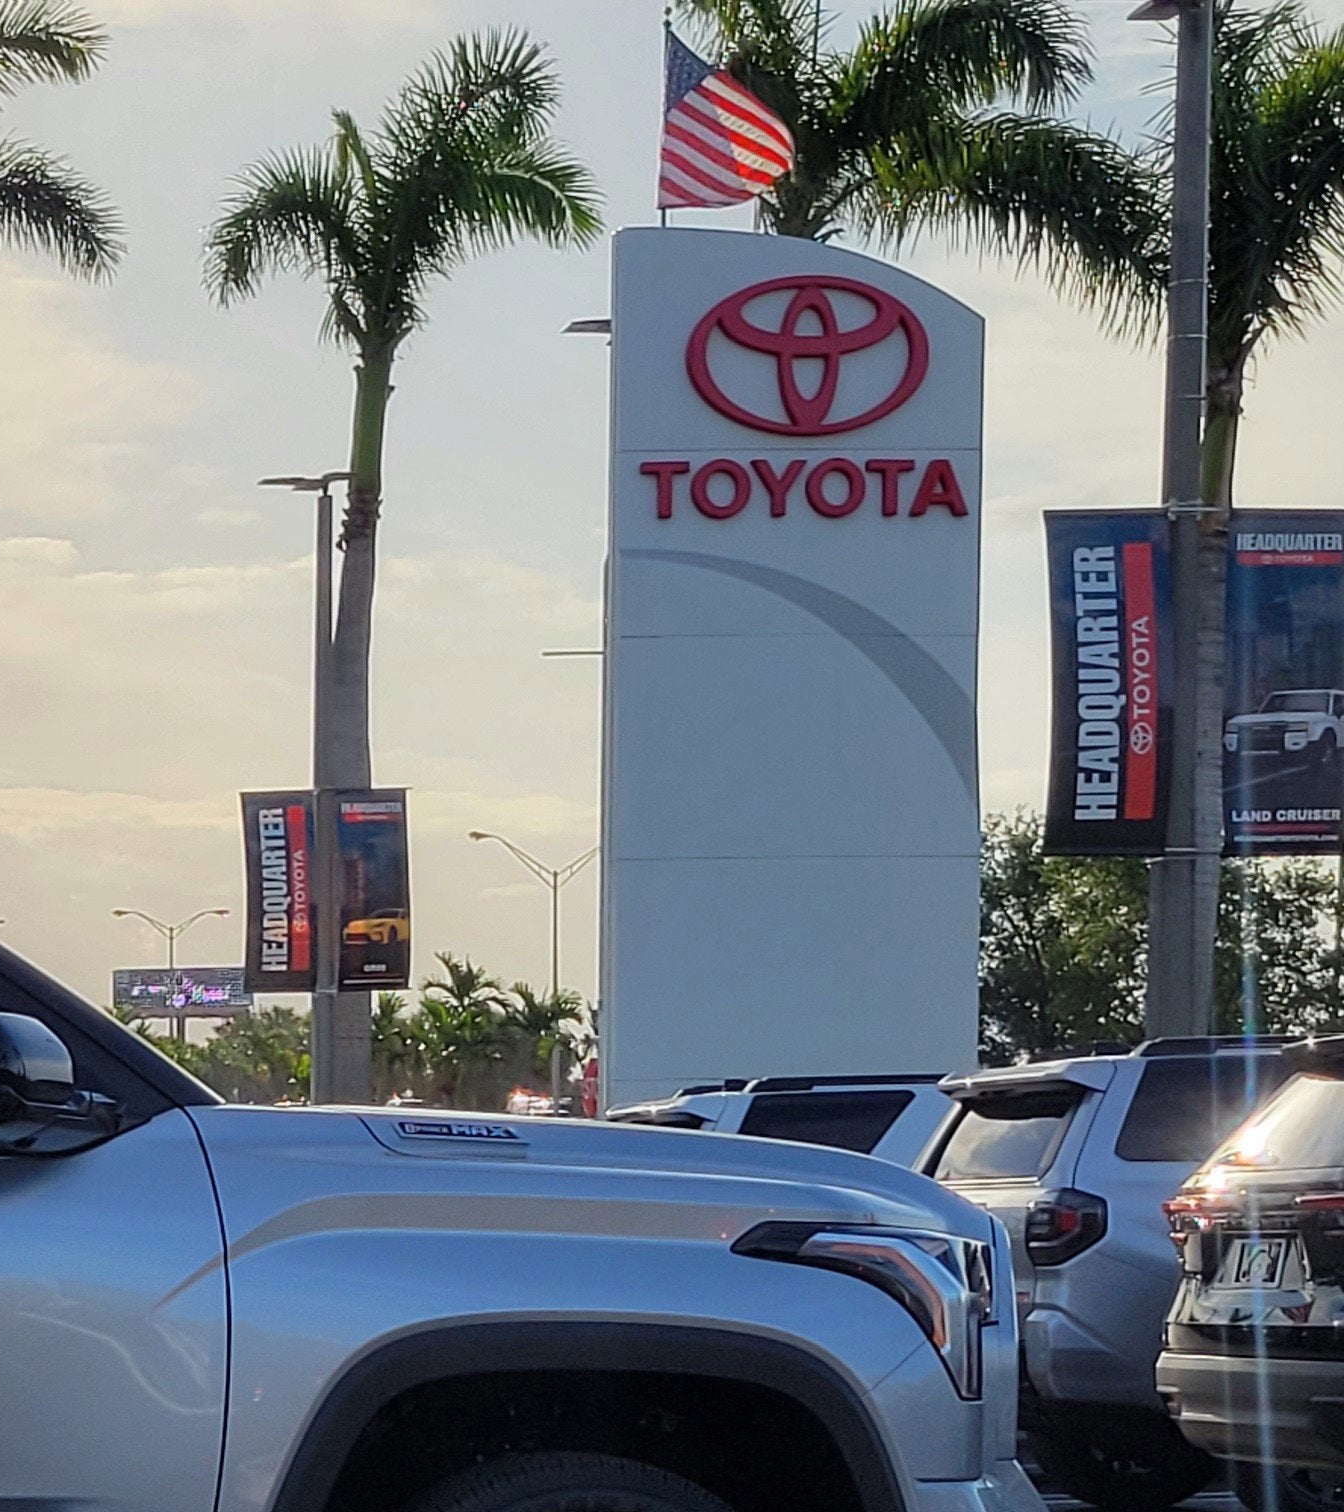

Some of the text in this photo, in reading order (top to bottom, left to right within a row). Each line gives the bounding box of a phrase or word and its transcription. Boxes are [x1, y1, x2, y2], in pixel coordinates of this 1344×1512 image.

[640, 457, 968, 519] TOYOTA
[1236, 532, 1342, 553] HEADQUARTER
[1073, 546, 1127, 821] HEADQUARTER
[1131, 616, 1150, 718] TOYOTA
[1231, 809, 1341, 822] LAND CRUISER
[260, 808, 291, 971] HEADQUARTER
[294, 850, 305, 911] TOYOTA
